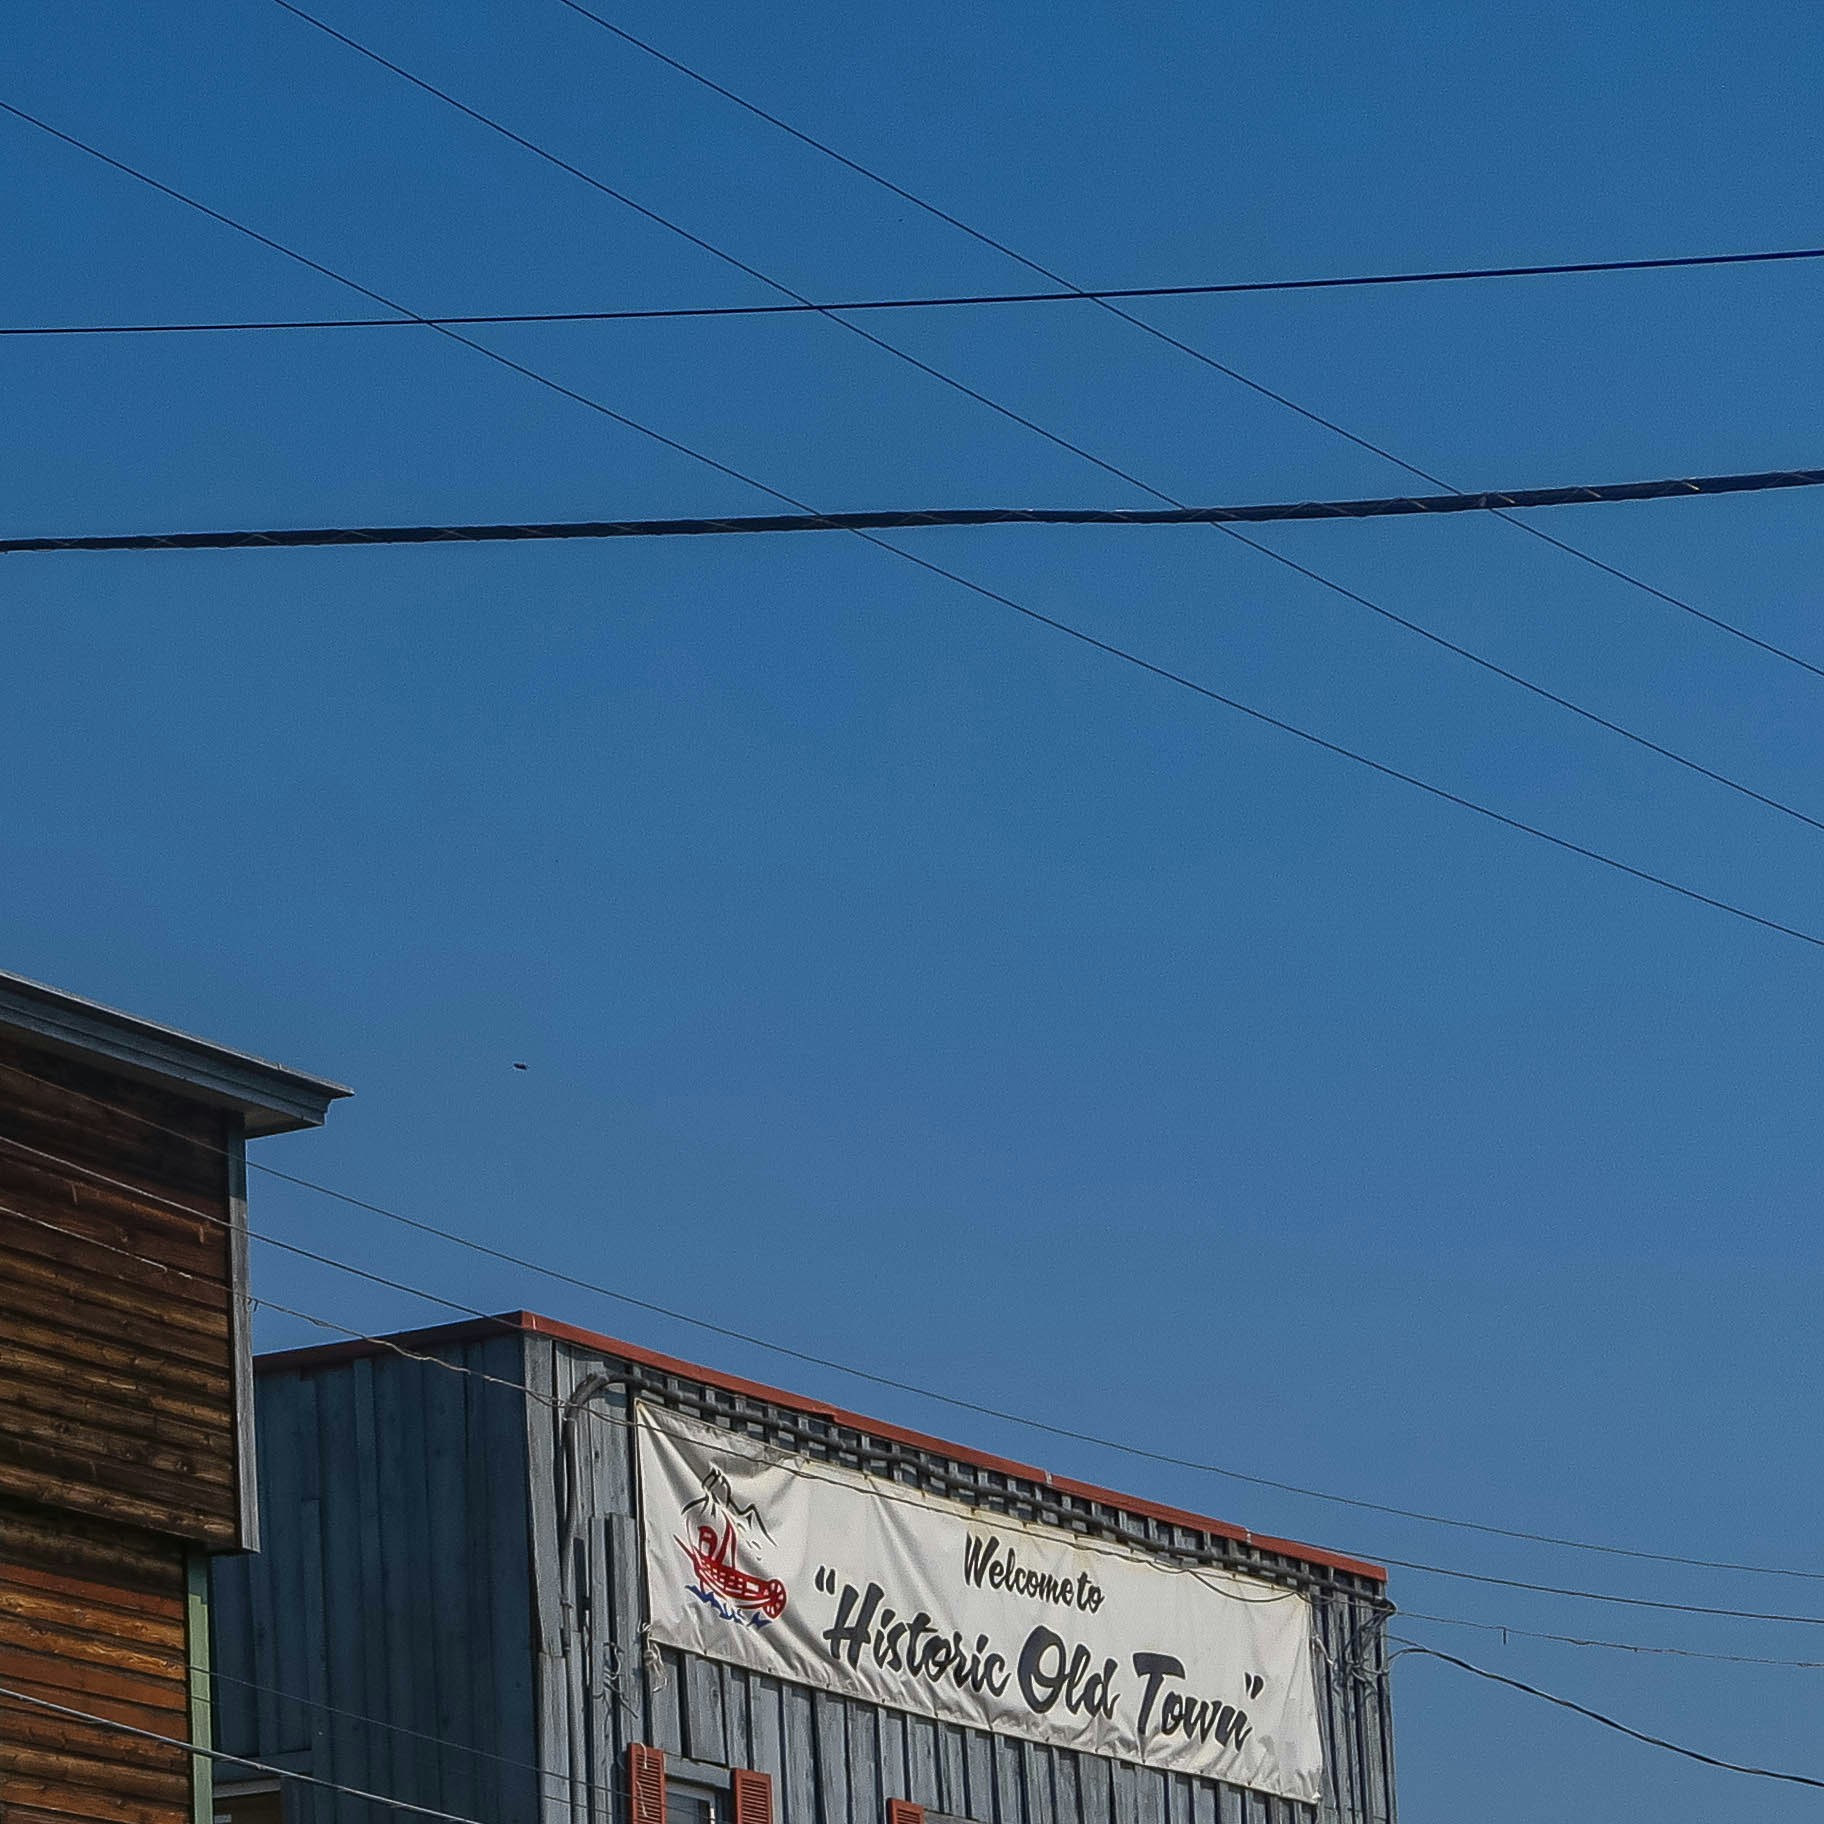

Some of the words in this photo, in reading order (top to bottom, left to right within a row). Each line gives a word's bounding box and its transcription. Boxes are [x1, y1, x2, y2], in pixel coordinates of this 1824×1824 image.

[964, 1531, 1074, 1607] Welcome
[1075, 1571, 1106, 1614] to
[1017, 1624, 1120, 1720] Old
